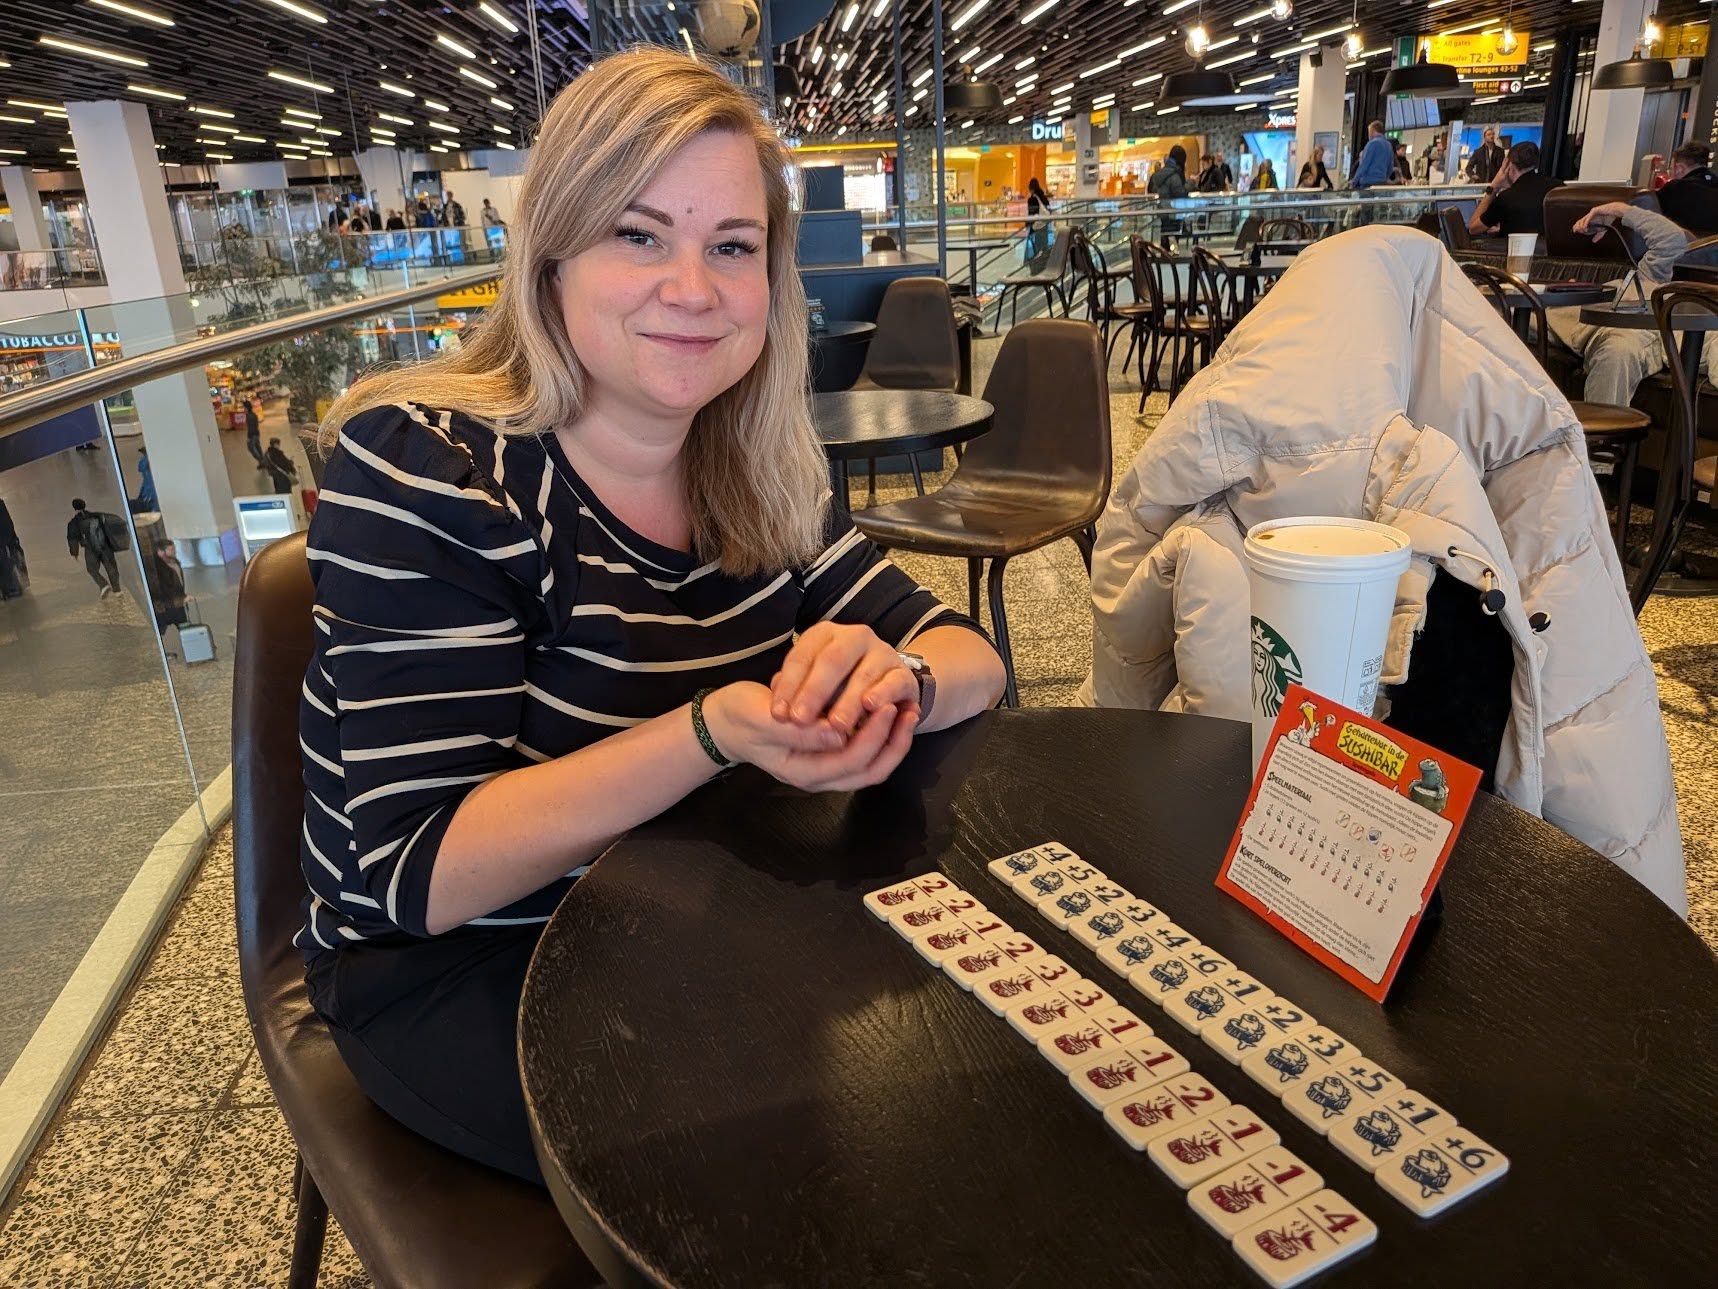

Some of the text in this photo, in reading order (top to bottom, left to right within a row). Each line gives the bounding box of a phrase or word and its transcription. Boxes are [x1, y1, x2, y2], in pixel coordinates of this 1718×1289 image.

[1470, 52, 1494, 63] T2-9
[1472, 66, 1498, 75] lounges
[1488, 80, 1499, 88] aid
[1032, 123, 1062, 140] Dru
[0, 334, 77, 348] TOBACCO
[1338, 734, 1400, 777] SUSHIBAR
[1396, 748, 1405, 762] de
[1266, 770, 1314, 803] SPEELMATERIAAL
[1042, 846, 1071, 861] +4
[1238, 844, 1255, 861] KORT
[1067, 865, 1097, 881] +5
[924, 879, 948, 893] -2
[1094, 885, 1125, 902] +2
[950, 898, 975, 912] -2
[1126, 905, 1157, 922] +3
[976, 920, 1002, 934] -1
[1156, 928, 1192, 948] +4
[1005, 940, 1034, 956] -2
[1190, 952, 1227, 973] +6
[1039, 964, 1068, 981] -3
[1227, 978, 1261, 998] +1
[1073, 989, 1103, 1007] -3
[1266, 1003, 1303, 1028] +2
[1108, 1017, 1138, 1034] -1
[1308, 1034, 1345, 1057] +3
[1141, 1049, 1174, 1068] -1
[1349, 1065, 1391, 1091] +5
[1179, 1086, 1215, 1108] -2
[1397, 1099, 1440, 1124] +1
[1226, 1118, 1263, 1142] -1
[1444, 1136, 1496, 1170] +6
[1266, 1161, 1306, 1186] -1
[1314, 1204, 1359, 1234] -4
